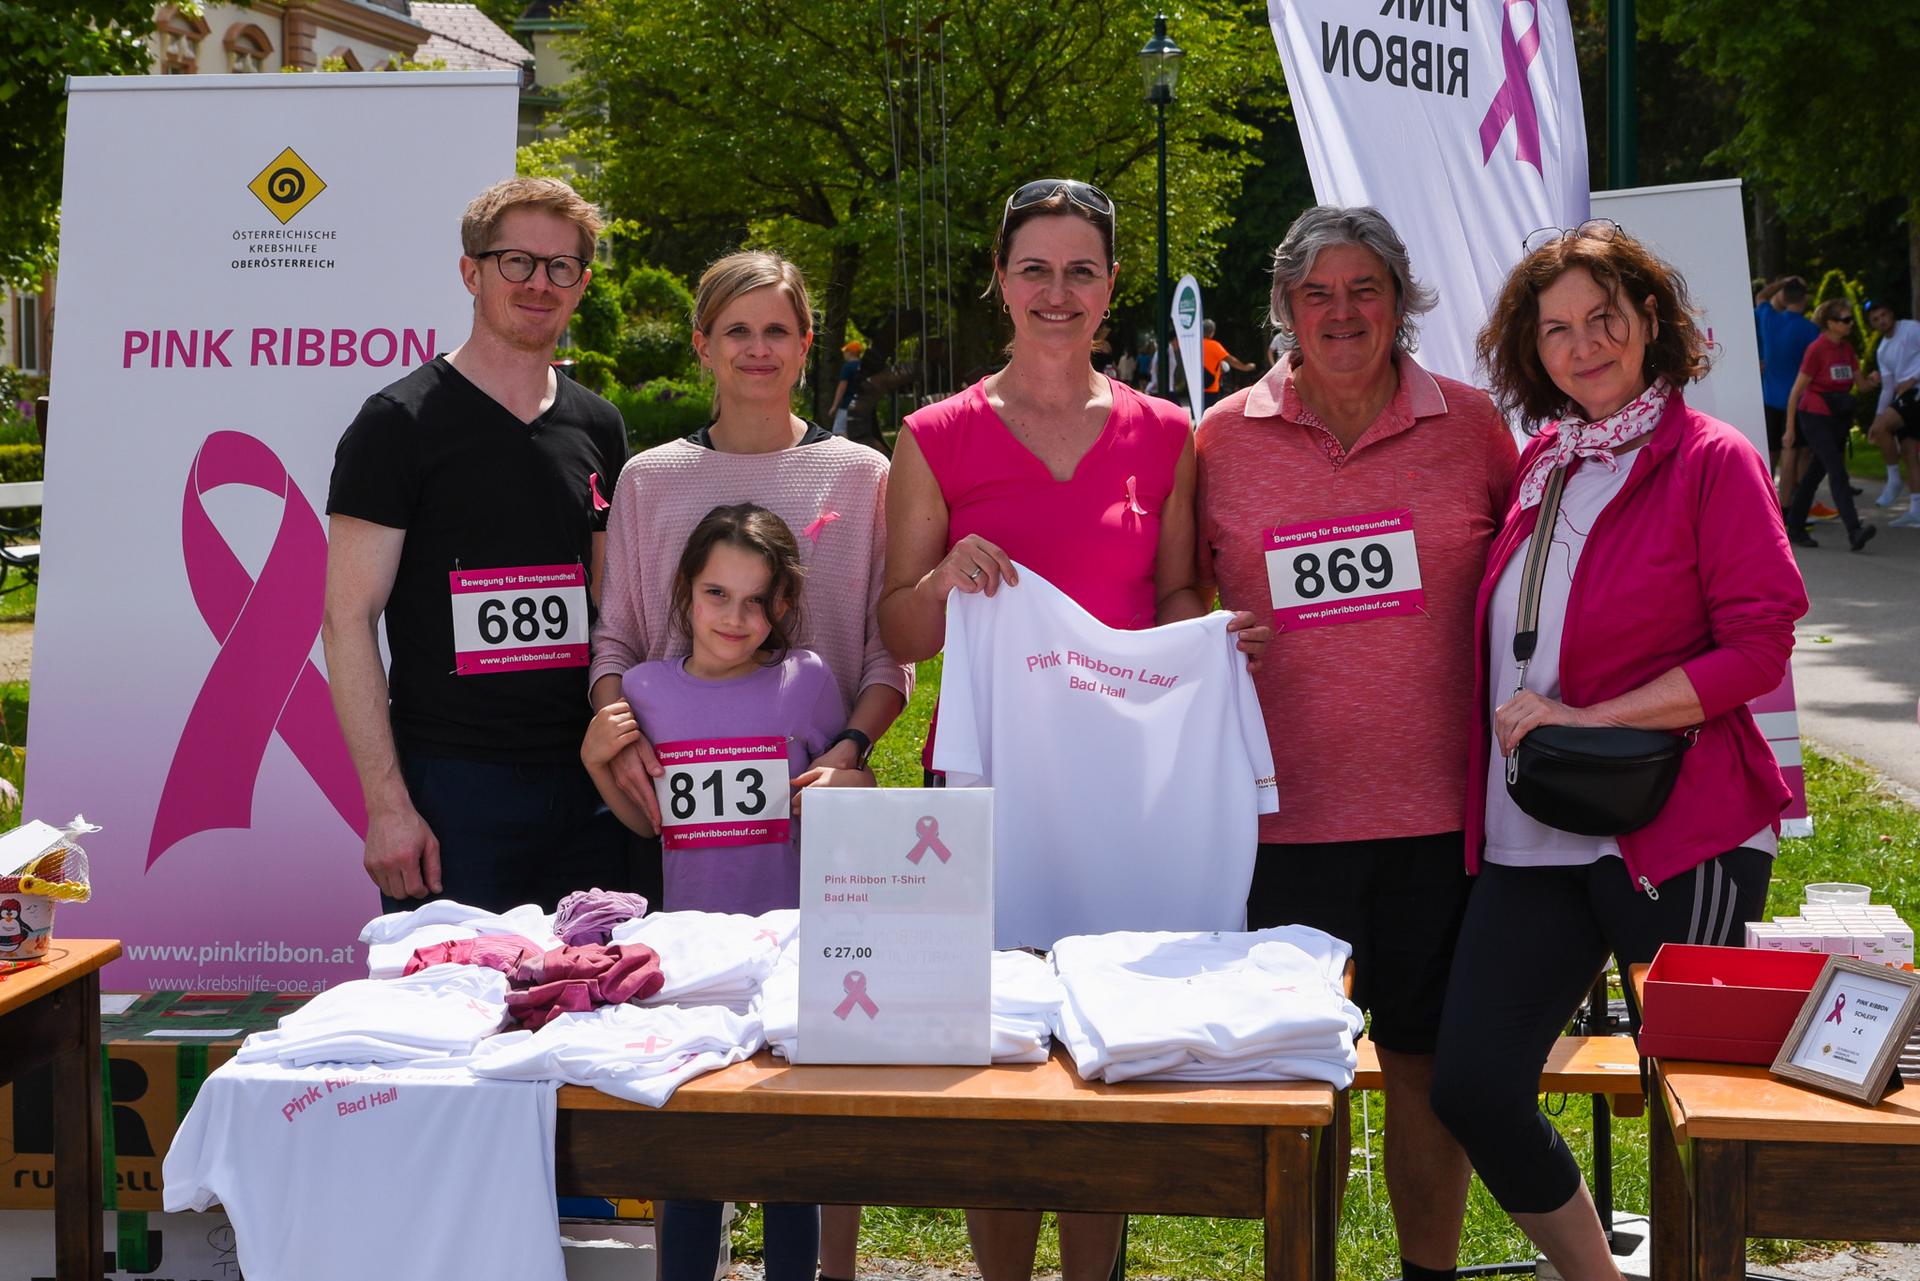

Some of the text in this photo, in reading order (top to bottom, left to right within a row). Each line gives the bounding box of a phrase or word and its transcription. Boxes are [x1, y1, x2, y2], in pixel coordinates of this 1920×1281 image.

[232, 230, 337, 240] ÖSTERREICHISCHE
[249, 244, 317, 253] KREBSHILFE
[231, 257, 335, 269] OBERÖSTERREICH
[123, 327, 436, 369] PINK RIBBON
[1273, 518, 1401, 543] Bewegung für Brustgesundheit
[461, 573, 576, 587] Bewegung für Brustgesundheit
[1292, 543, 1394, 599] 869
[1298, 600, 1400, 620] www.pinkribbonlauf.com
[477, 595, 569, 645] 689
[480, 652, 571, 665] www.pinkribbonlauf.com
[1026, 650, 1179, 689] Pink Ribbon Lauf
[1069, 676, 1126, 699] Bad Hall
[695, 748, 707, 756] für
[709, 745, 777, 756] Brustgesundheit
[670, 768, 767, 820] 813
[674, 828, 768, 840] www.pinkribbonlauf.com
[824, 875, 926, 885] Pink Ribbon T-Shirt
[824, 893, 869, 902] Bad Hall
[127, 941, 355, 967] www.pinkribbon.at
[823, 947, 832, 959] €
[834, 947, 872, 960] 27,00
[148, 974, 328, 993] www.krebshilfe-ooe.at
[1856, 998, 1889, 1012] PINK RIBBON
[281, 1085, 324, 1122] Pink
[337, 1087, 398, 1116] Bad Hall
